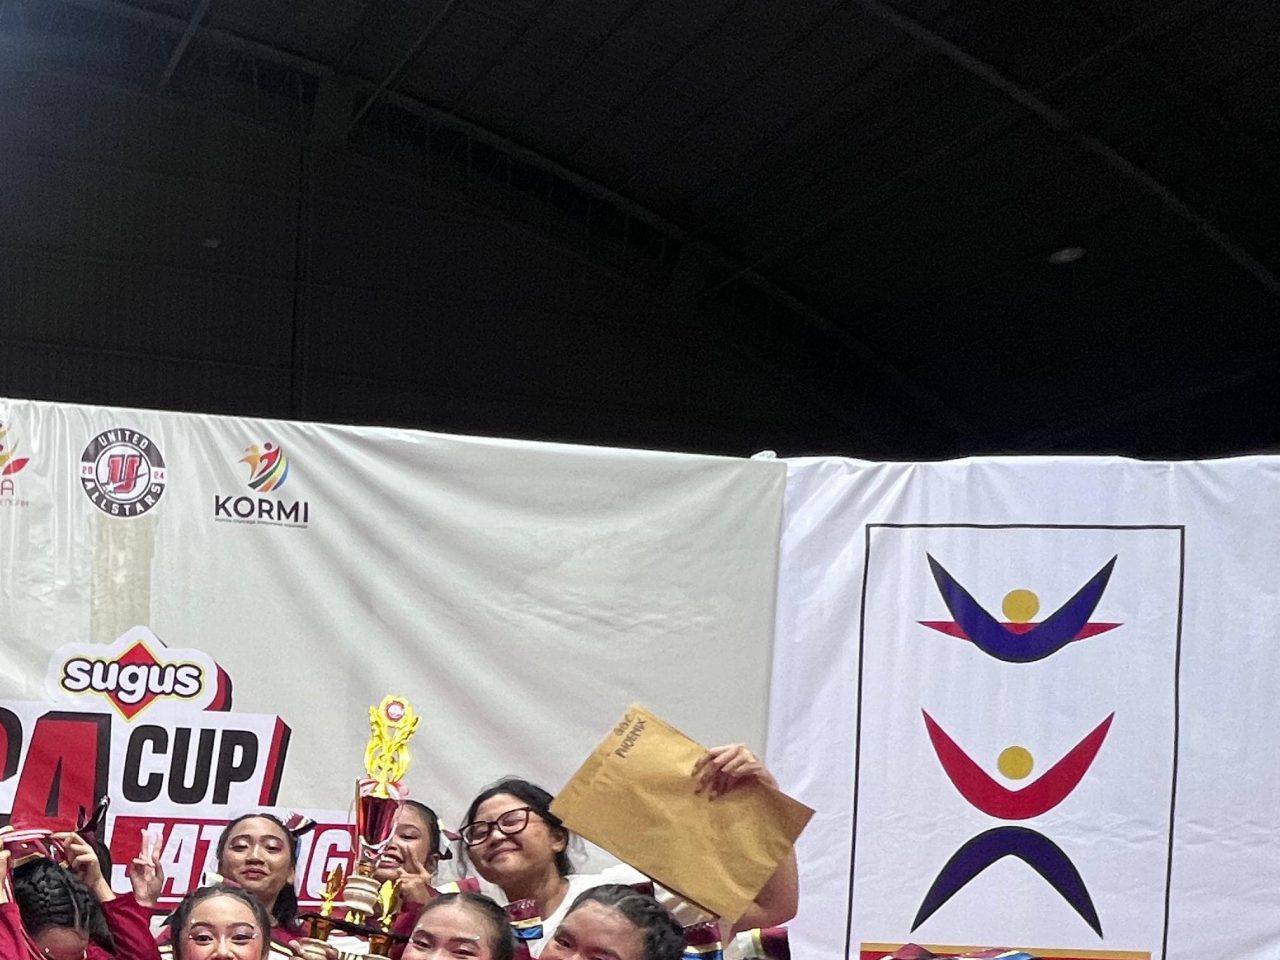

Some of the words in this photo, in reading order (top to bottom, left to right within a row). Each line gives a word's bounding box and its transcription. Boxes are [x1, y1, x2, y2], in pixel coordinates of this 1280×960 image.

[98, 431, 149, 450] UNITED
[82, 466, 93, 475] 20
[215, 495, 308, 522] KORMI
[62, 658, 202, 704] sugus
[122, 725, 259, 805] CUP
